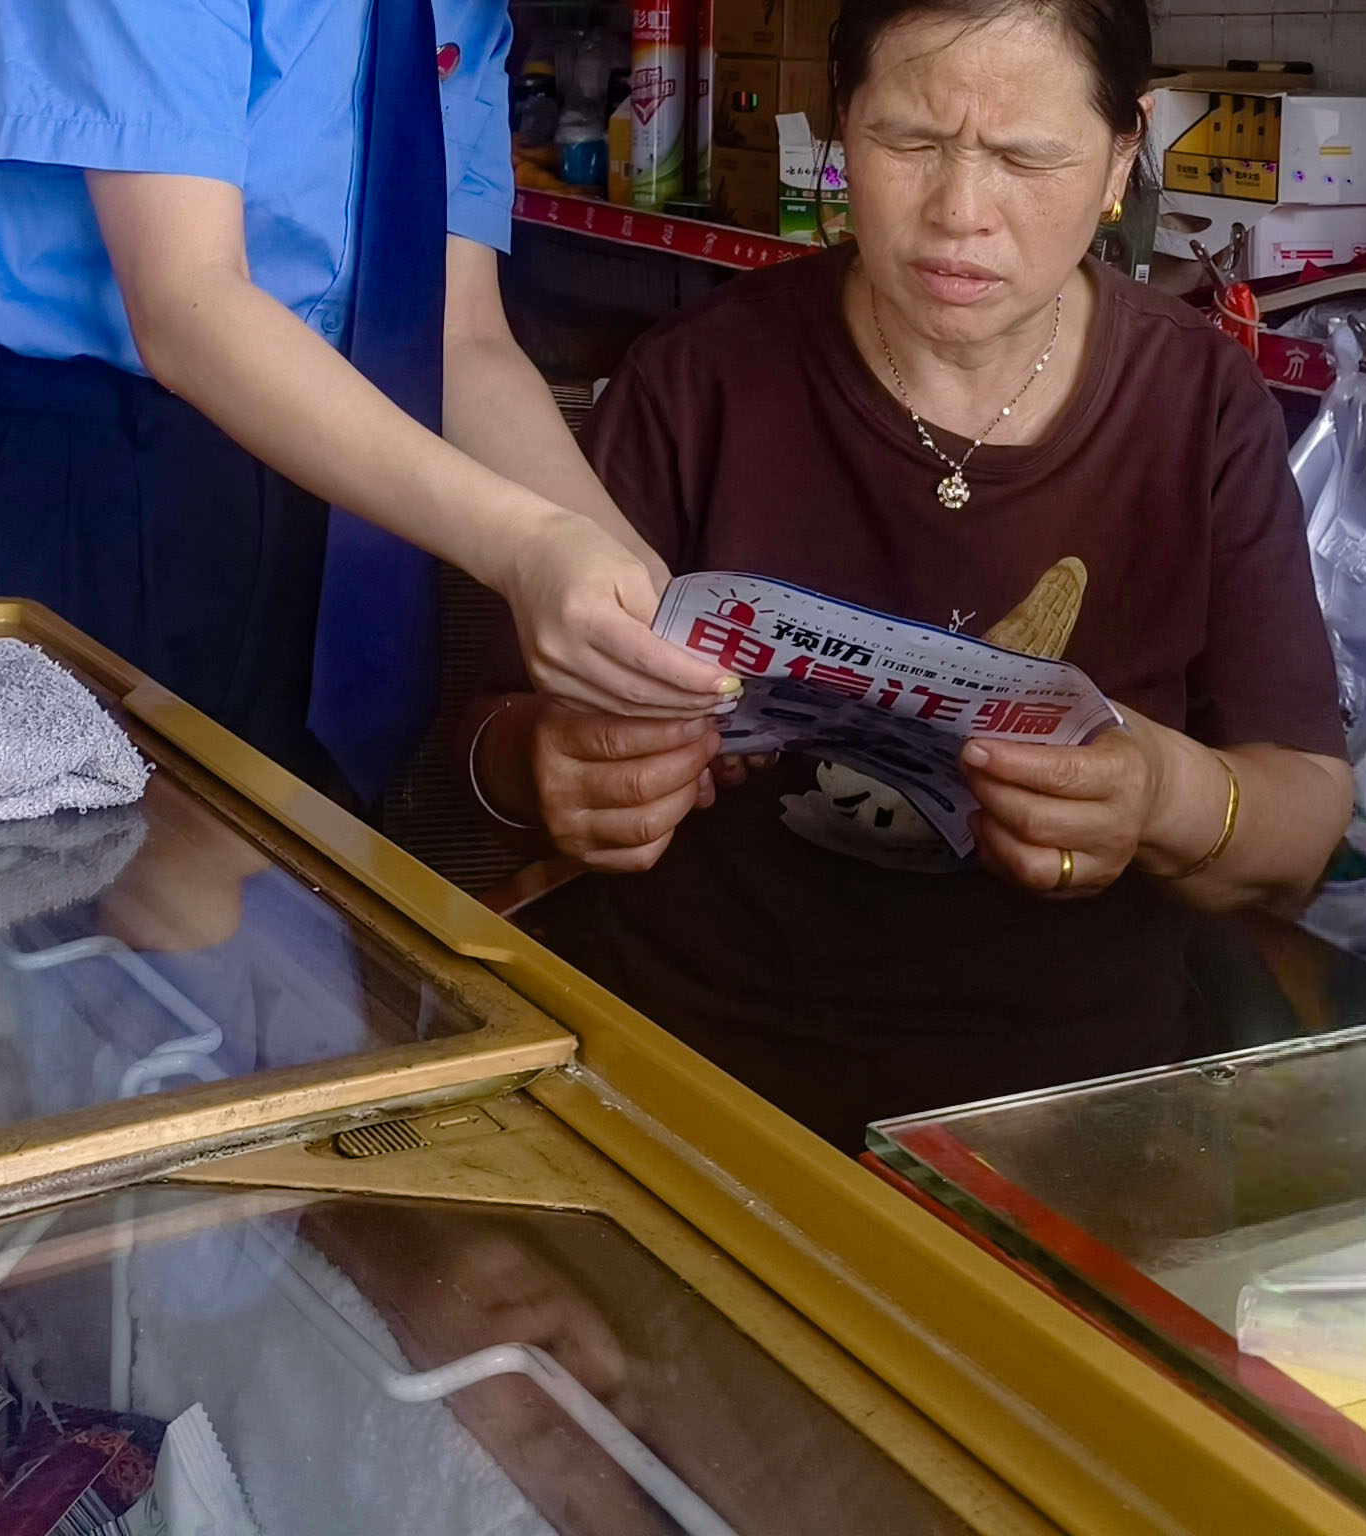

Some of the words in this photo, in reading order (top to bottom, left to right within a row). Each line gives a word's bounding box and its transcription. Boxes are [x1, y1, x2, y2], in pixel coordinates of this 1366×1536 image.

[686, 616, 1073, 738] 电信诈骗
[770, 619, 876, 667] 预防
